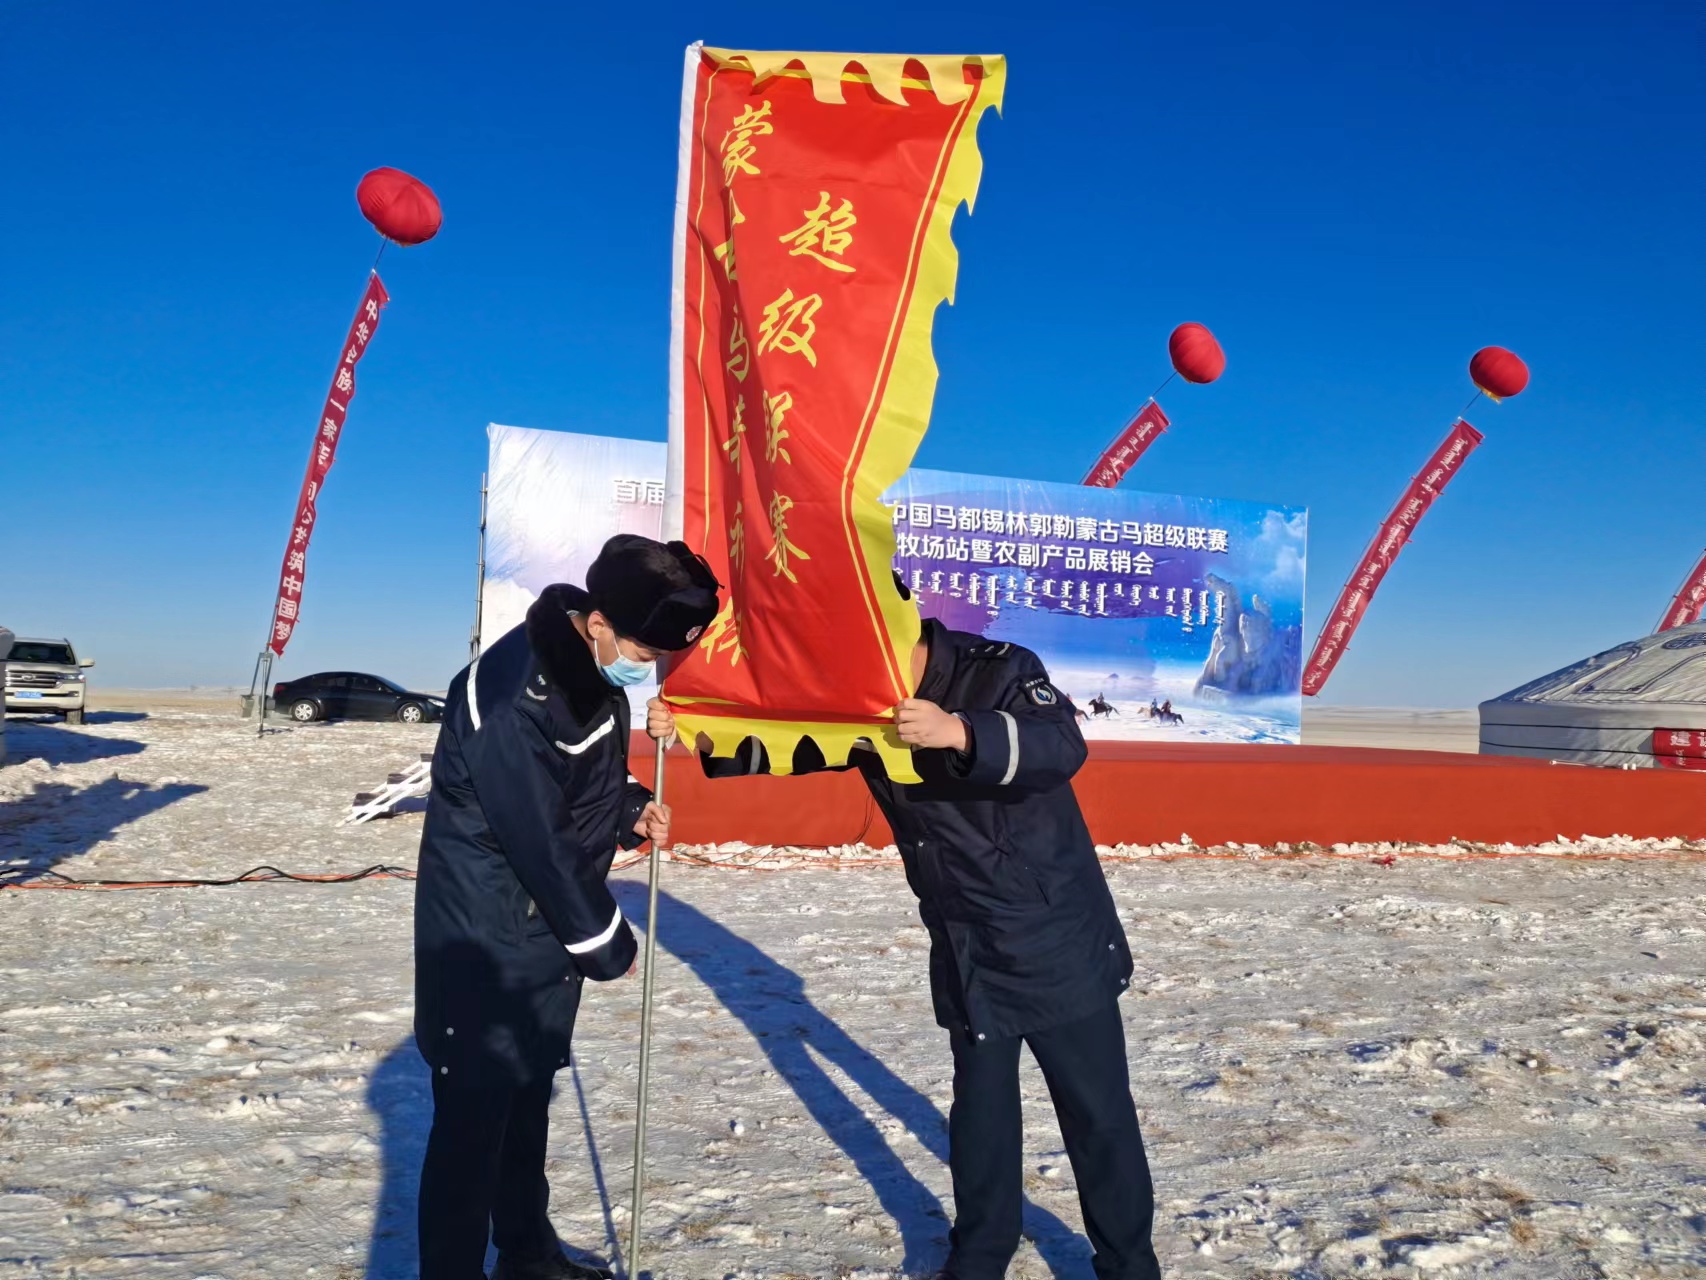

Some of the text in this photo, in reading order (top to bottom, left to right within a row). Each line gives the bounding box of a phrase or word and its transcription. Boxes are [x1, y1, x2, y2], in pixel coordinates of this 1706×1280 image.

[896, 532, 1154, 576] 牧场站暨农副产品展销会
